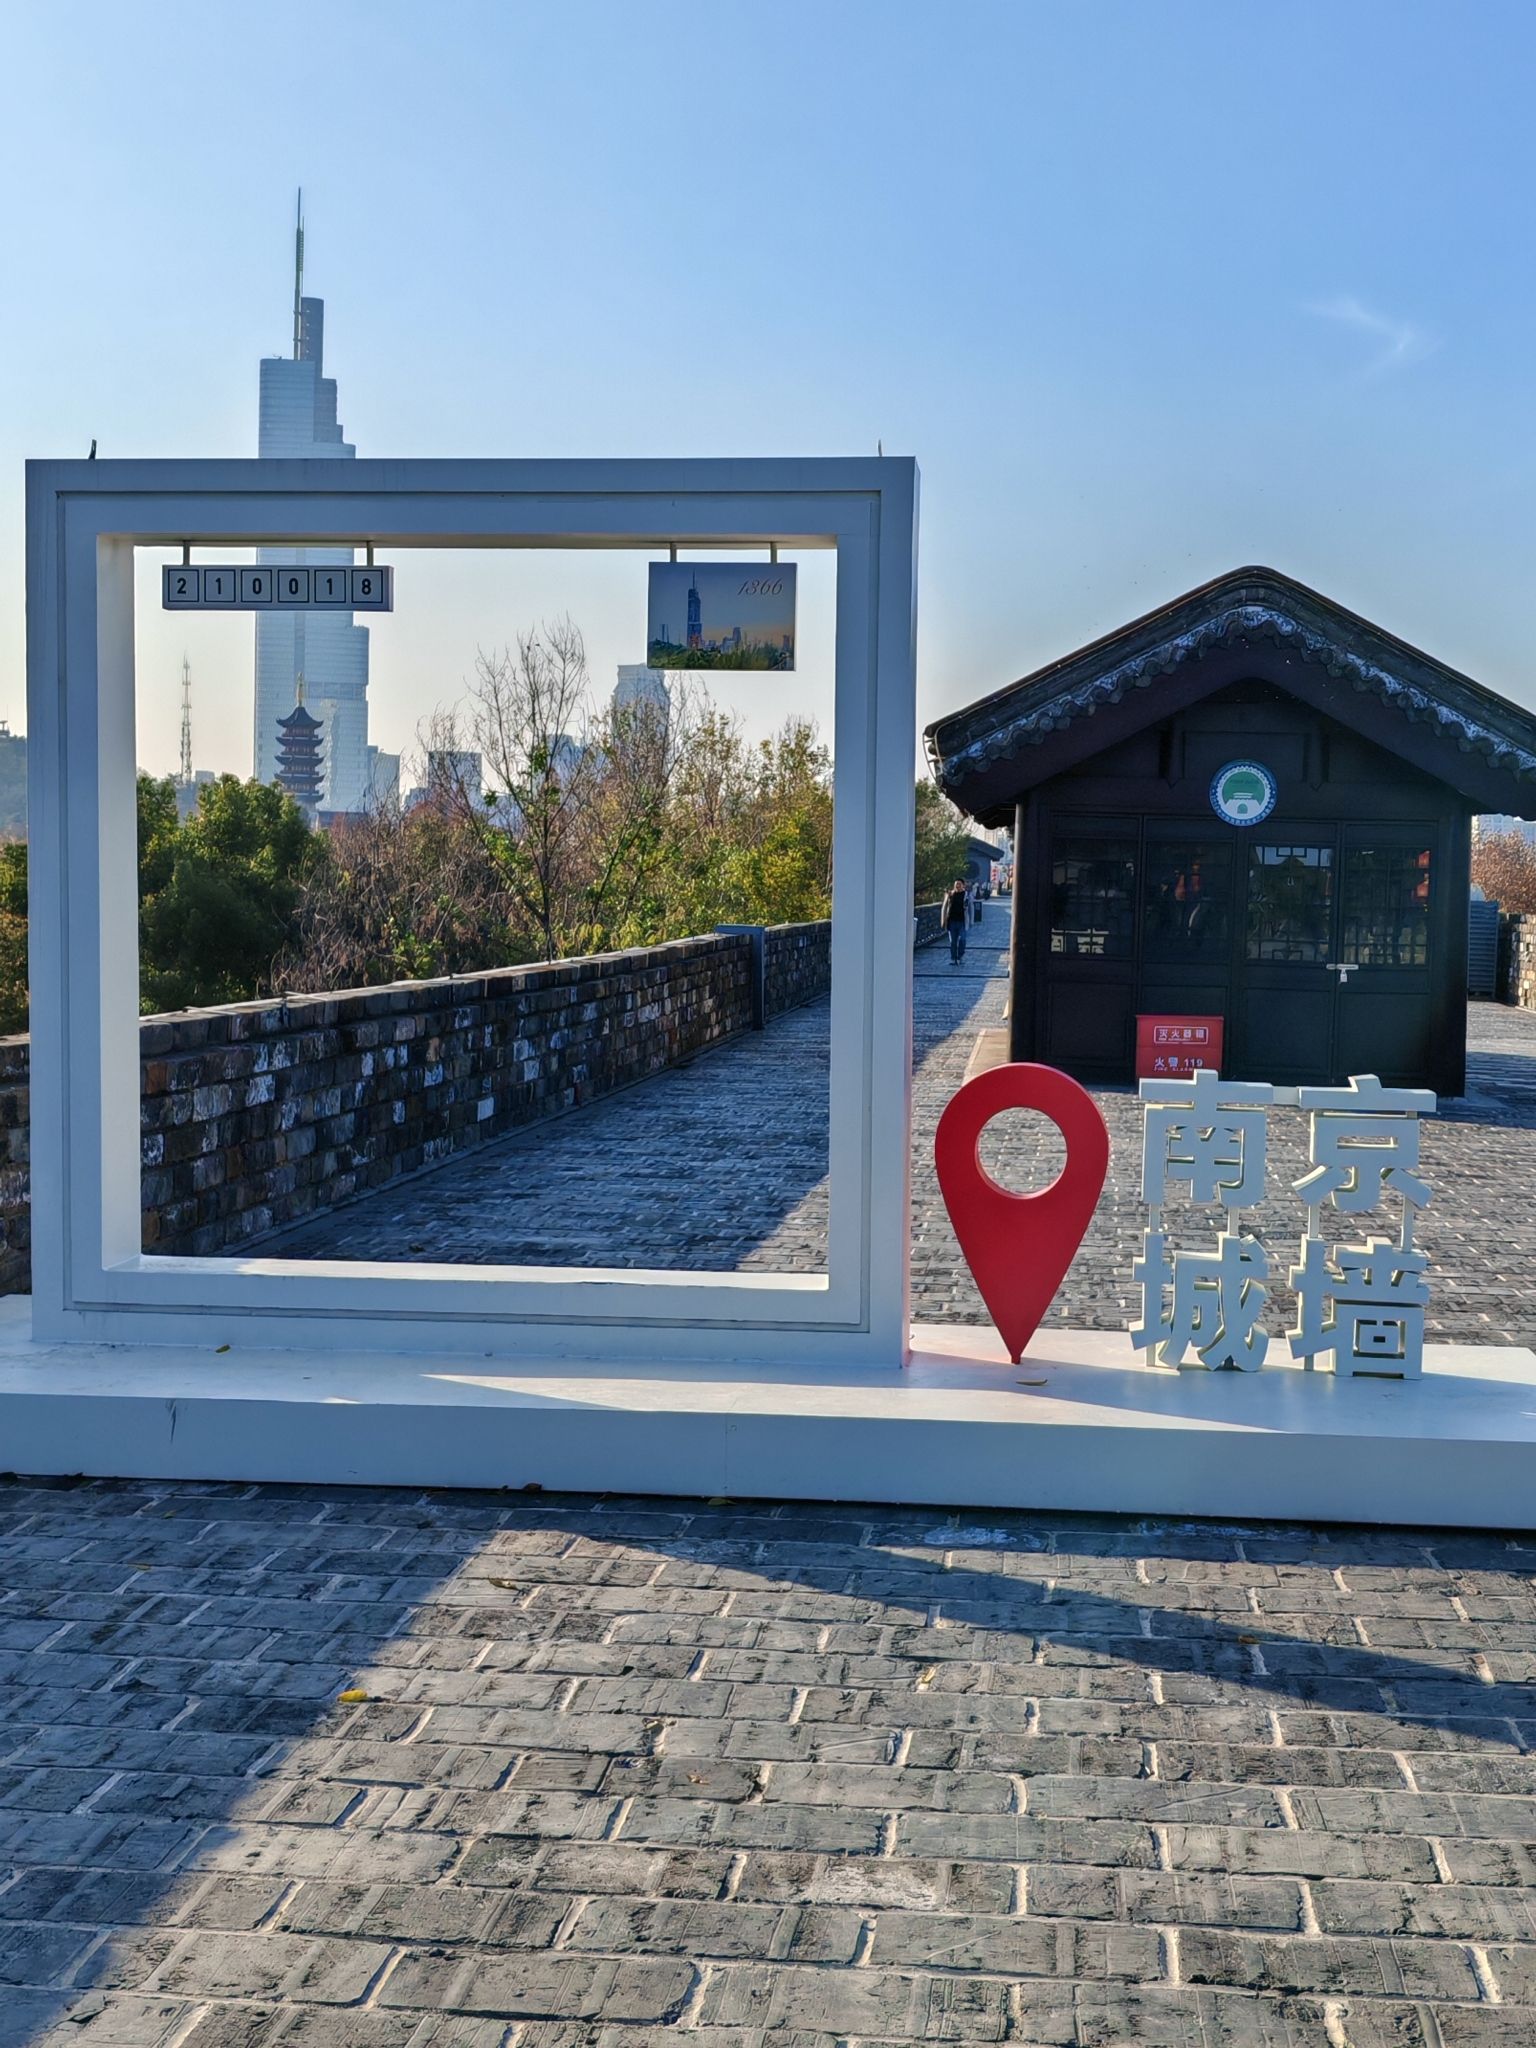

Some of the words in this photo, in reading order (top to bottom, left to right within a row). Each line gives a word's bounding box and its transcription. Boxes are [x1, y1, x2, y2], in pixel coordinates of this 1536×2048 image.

[176, 577, 373, 596] 210018
[736, 576, 783, 597] 1366
[1184, 1058, 1203, 1067] 119
[1139, 1069, 1437, 1212] 南京
[1128, 1228, 1430, 1380] 城墙
